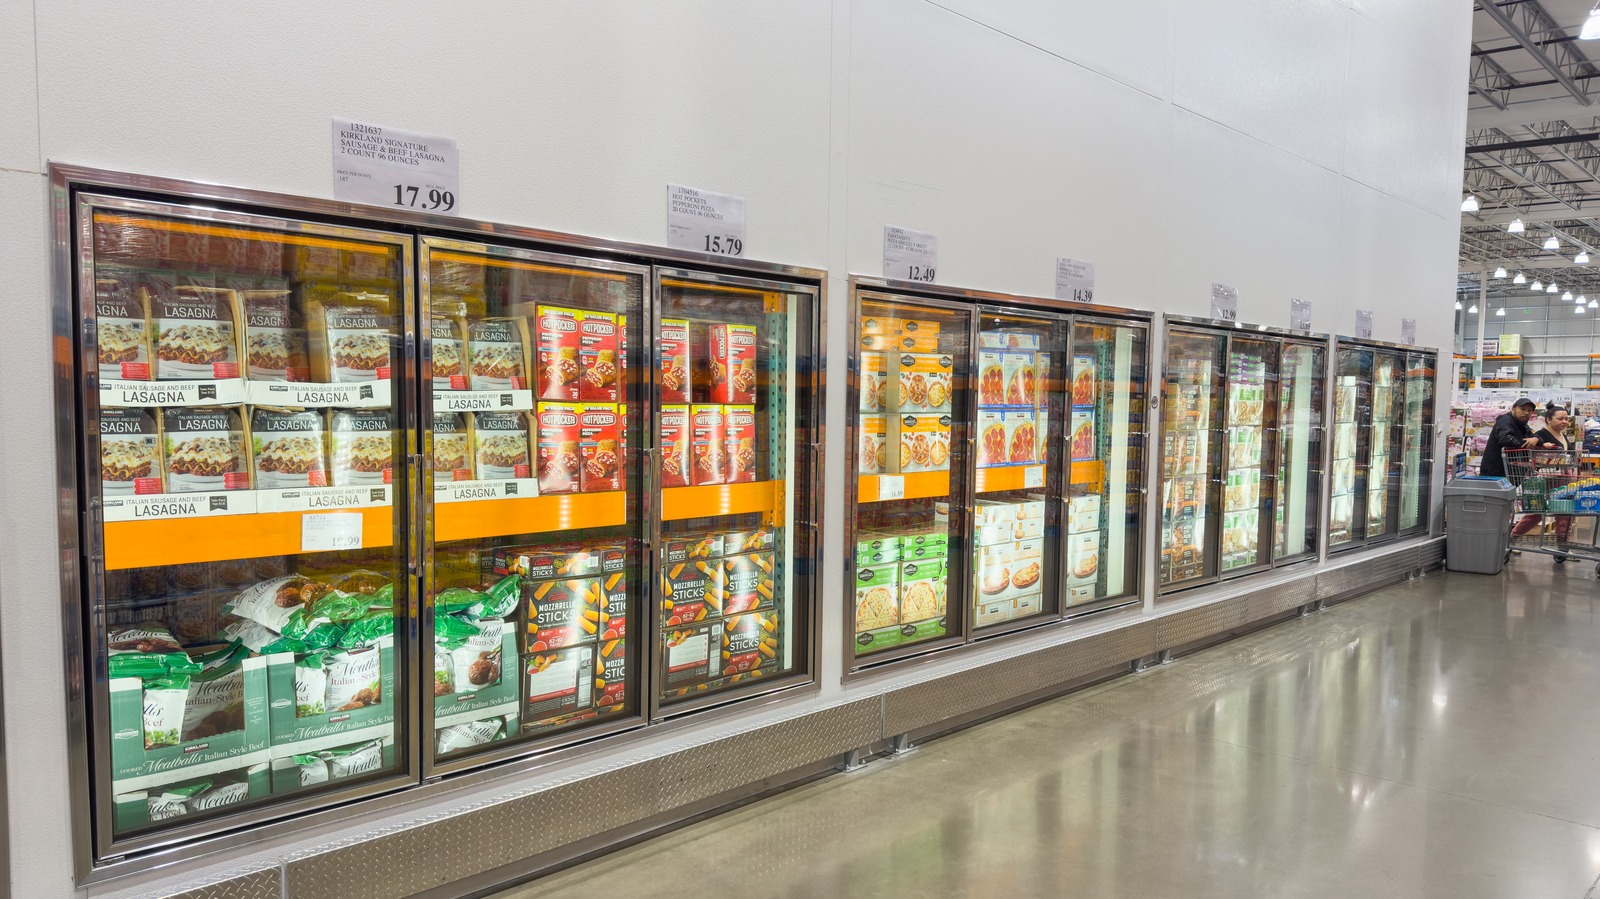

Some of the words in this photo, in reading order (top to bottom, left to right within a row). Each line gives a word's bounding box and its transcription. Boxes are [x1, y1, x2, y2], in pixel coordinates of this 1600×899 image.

[350, 123, 382, 135] 1321637
[340, 131, 382, 143] KIRKLAND
[385, 139, 428, 152] SIGNATURE
[341, 140, 378, 151] SAUSAGE
[388, 148, 407, 156] BEEF
[410, 151, 445, 163] LASAGNA
[347, 148, 375, 158] COUNT
[388, 155, 419, 165] OUNCES
[394, 184, 454, 211] 17.99
[678, 188, 698, 196] 1704516
[673, 200, 699, 209] PEPPERONI
[685, 196, 706, 204] POCKETS
[704, 235, 742, 255] 15.79
[908, 266, 935, 282] 12.49
[1073, 289, 1092, 302] 14.39
[97, 306, 128, 316] AGNA
[165, 307, 217, 318] LASAGNA
[1223, 309, 1236, 320] 12.99
[334, 318, 377, 328] LASAGNA
[583, 323, 594, 333] HOT
[594, 324, 613, 334] POCKETS
[432, 329, 452, 337] AGNA
[475, 332, 512, 341] LASAGNA
[123, 391, 185, 402] LASAGNA
[297, 392, 349, 403] LASAGNA
[449, 400, 491, 409] LASAGNA
[179, 419, 229, 430] LASAGNA
[267, 421, 313, 430] LASAGNA
[483, 421, 518, 429] LASAGNA
[583, 415, 593, 425] HOT
[593, 415, 613, 425] POCKETS
[455, 489, 496, 499] LASAGNA
[309, 495, 359, 507] LASAGNA
[135, 503, 196, 516] LASAGNA
[730, 571, 758, 581] MOZZARELLA
[673, 580, 704, 590] MOZZARELLA
[729, 579, 758, 591] STICKS
[673, 588, 704, 600] STICKS
[539, 601, 576, 612] MOZZARELLA
[538, 609, 576, 623] STICKS
[730, 638, 759, 651] STICKS
[605, 667, 625, 679] STIC
[435, 702, 471, 716] eatballs
[490, 698, 502, 706] Style
[290, 722, 346, 741] Meatballs
[347, 721, 366, 729] Italian
[368, 717, 383, 725] Style
[185, 743, 209, 751] KIRKLAND
[137, 753, 203, 775] Meatballs
[204, 751, 228, 761] Italian
[229, 747, 248, 755] Style
[249, 741, 264, 751] Beef
